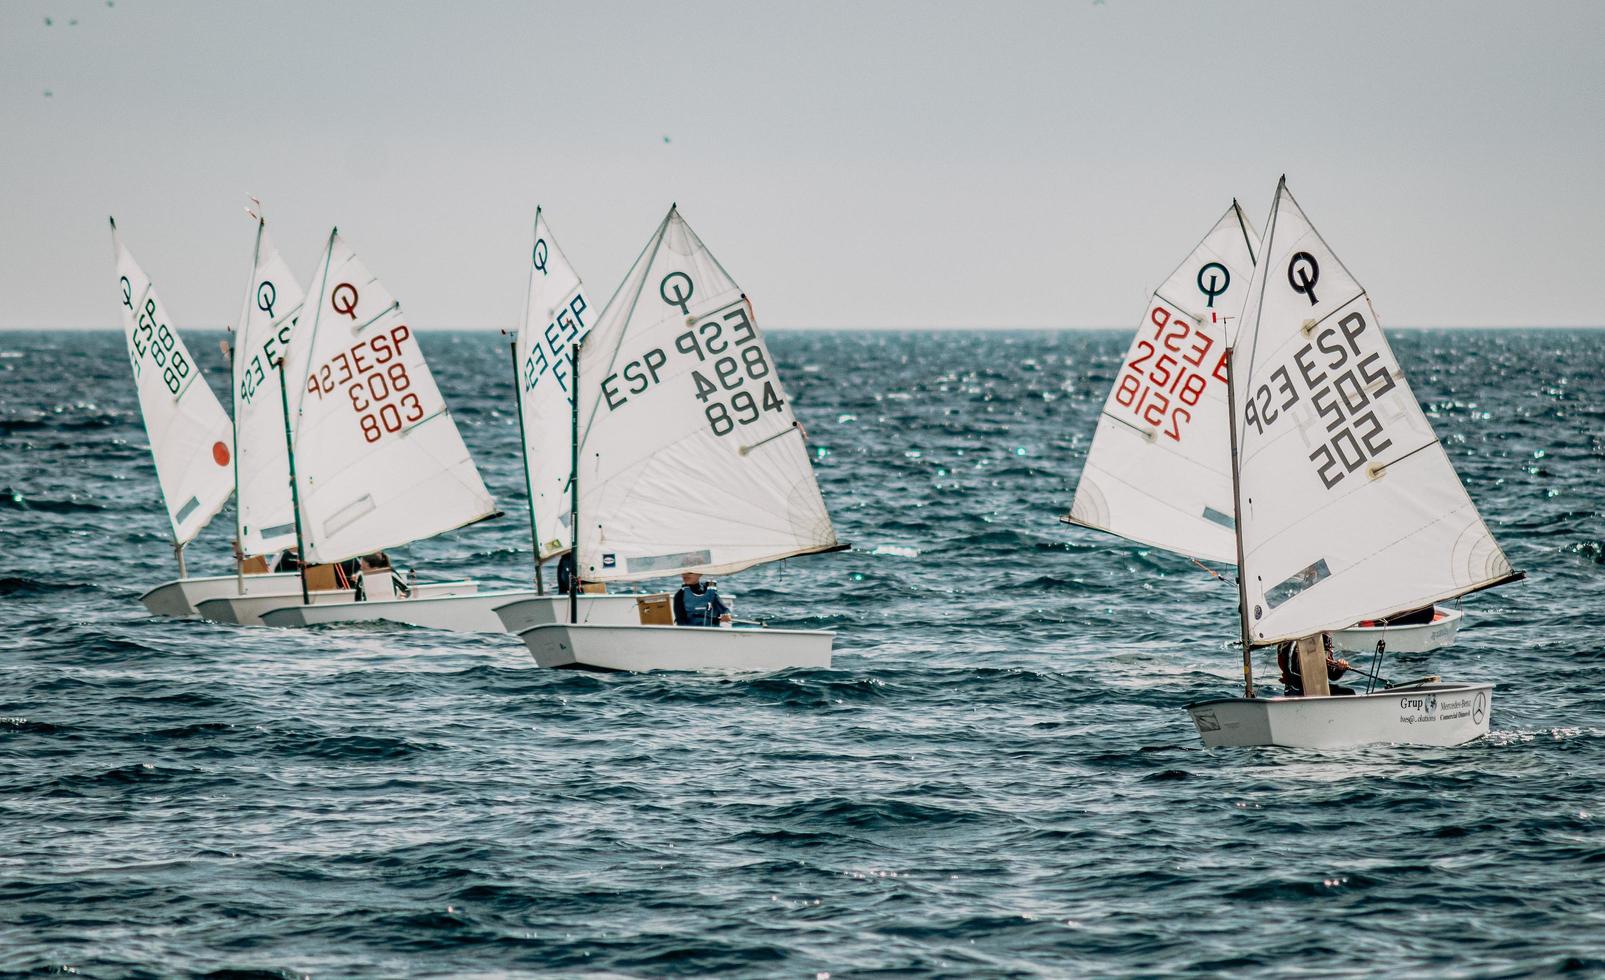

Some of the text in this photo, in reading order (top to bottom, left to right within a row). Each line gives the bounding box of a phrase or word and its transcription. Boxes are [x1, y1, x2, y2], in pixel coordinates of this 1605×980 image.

[133, 298, 157, 358] ESP
[351, 325, 410, 374] ESP
[544, 294, 587, 356] ESP
[1293, 311, 1366, 391] ESP
[163, 351, 189, 394] 88
[600, 348, 667, 411] ESP
[1128, 340, 1207, 407] 2518
[360, 393, 424, 443] 803
[705, 381, 784, 437] 894
[1400, 698, 1423, 711] Grup
